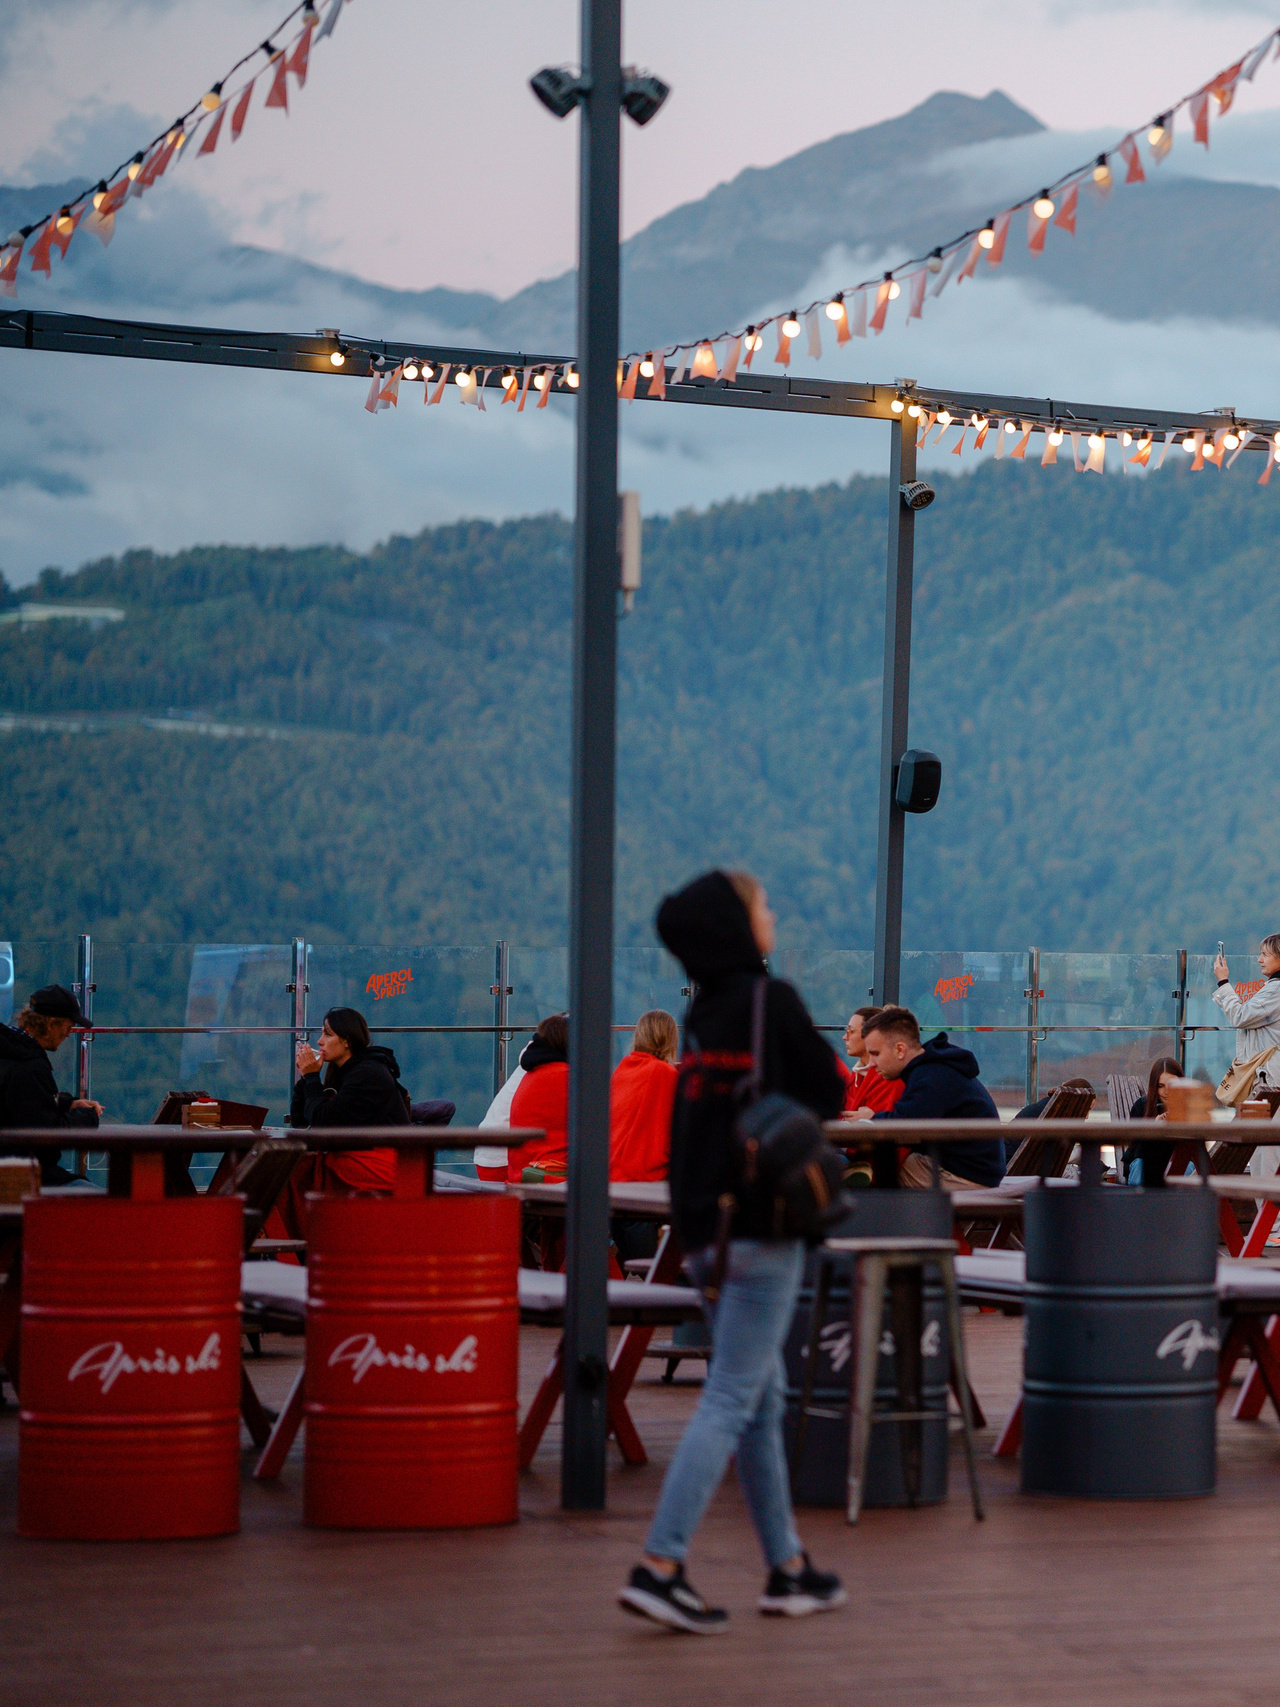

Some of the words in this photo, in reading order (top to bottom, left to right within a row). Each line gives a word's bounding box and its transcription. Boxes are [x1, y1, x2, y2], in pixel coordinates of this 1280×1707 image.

[366, 968, 414, 993] APEROL
[934, 973, 974, 996] APEROL
[1234, 979, 1265, 996] APERO
[374, 983, 406, 1000] SPRITZ
